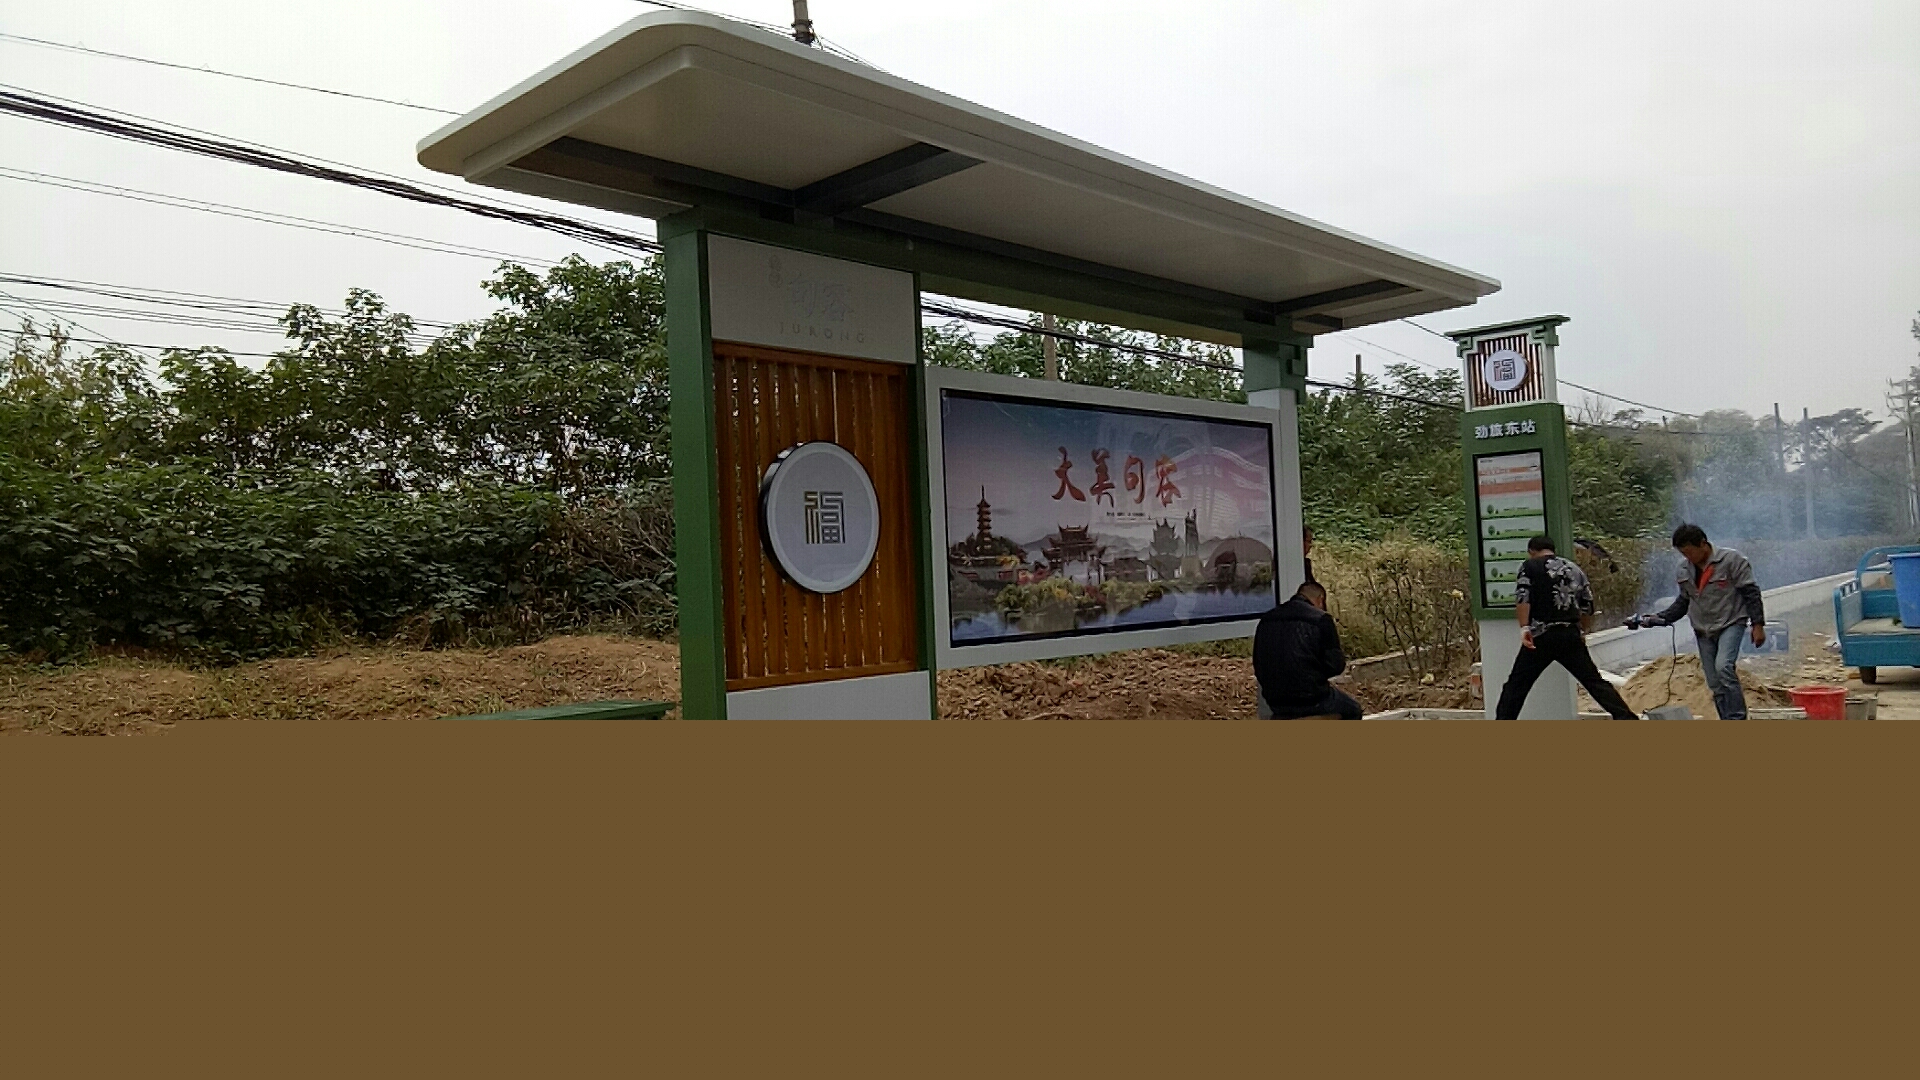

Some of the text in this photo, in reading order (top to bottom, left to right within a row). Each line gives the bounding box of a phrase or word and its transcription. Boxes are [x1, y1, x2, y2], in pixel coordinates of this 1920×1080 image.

[779, 321, 865, 344] JURONG
[1051, 446, 1181, 508] 大美句容
